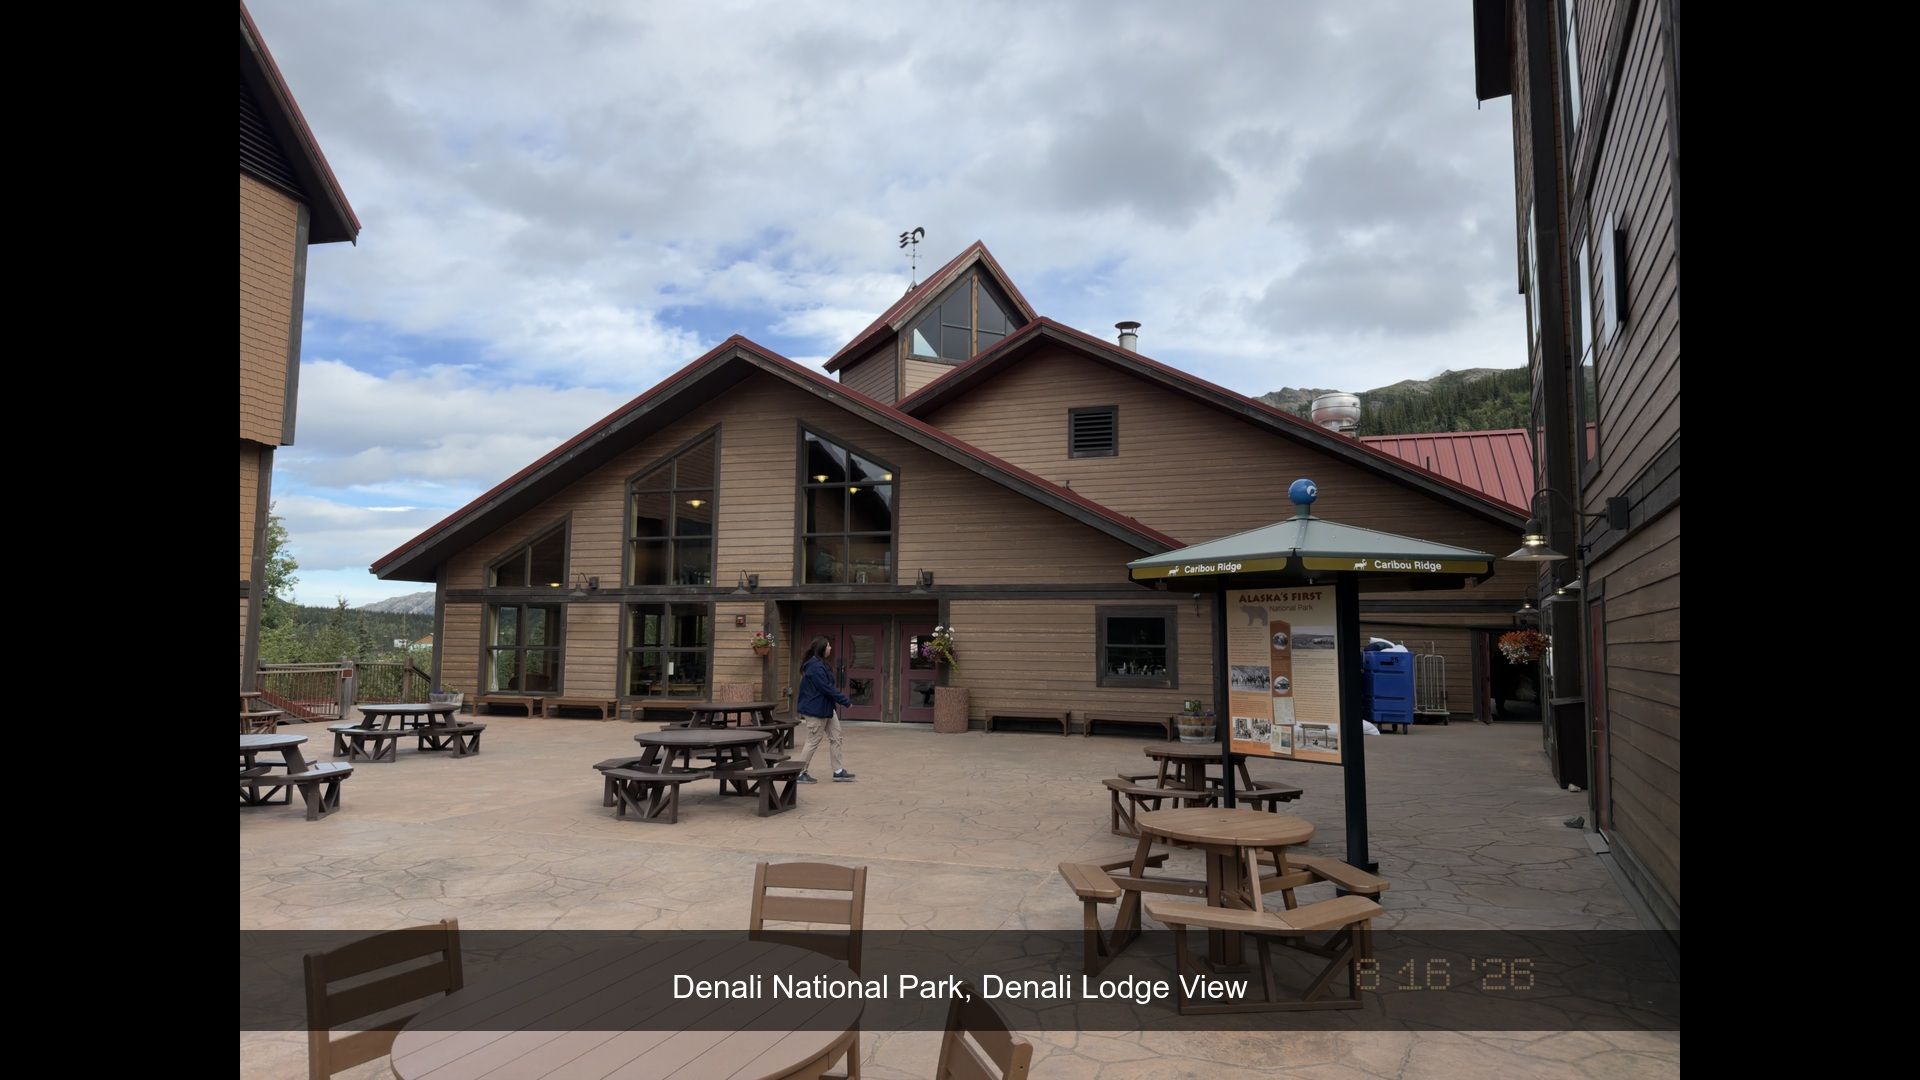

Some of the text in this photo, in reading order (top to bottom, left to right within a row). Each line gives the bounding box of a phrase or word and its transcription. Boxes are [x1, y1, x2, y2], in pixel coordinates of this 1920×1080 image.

[1184, 562, 1242, 573] Caribou Ridge
[1373, 560, 1442, 572] Caribou Ridge
[1239, 592, 1322, 603] ALASKA'S FIRST
